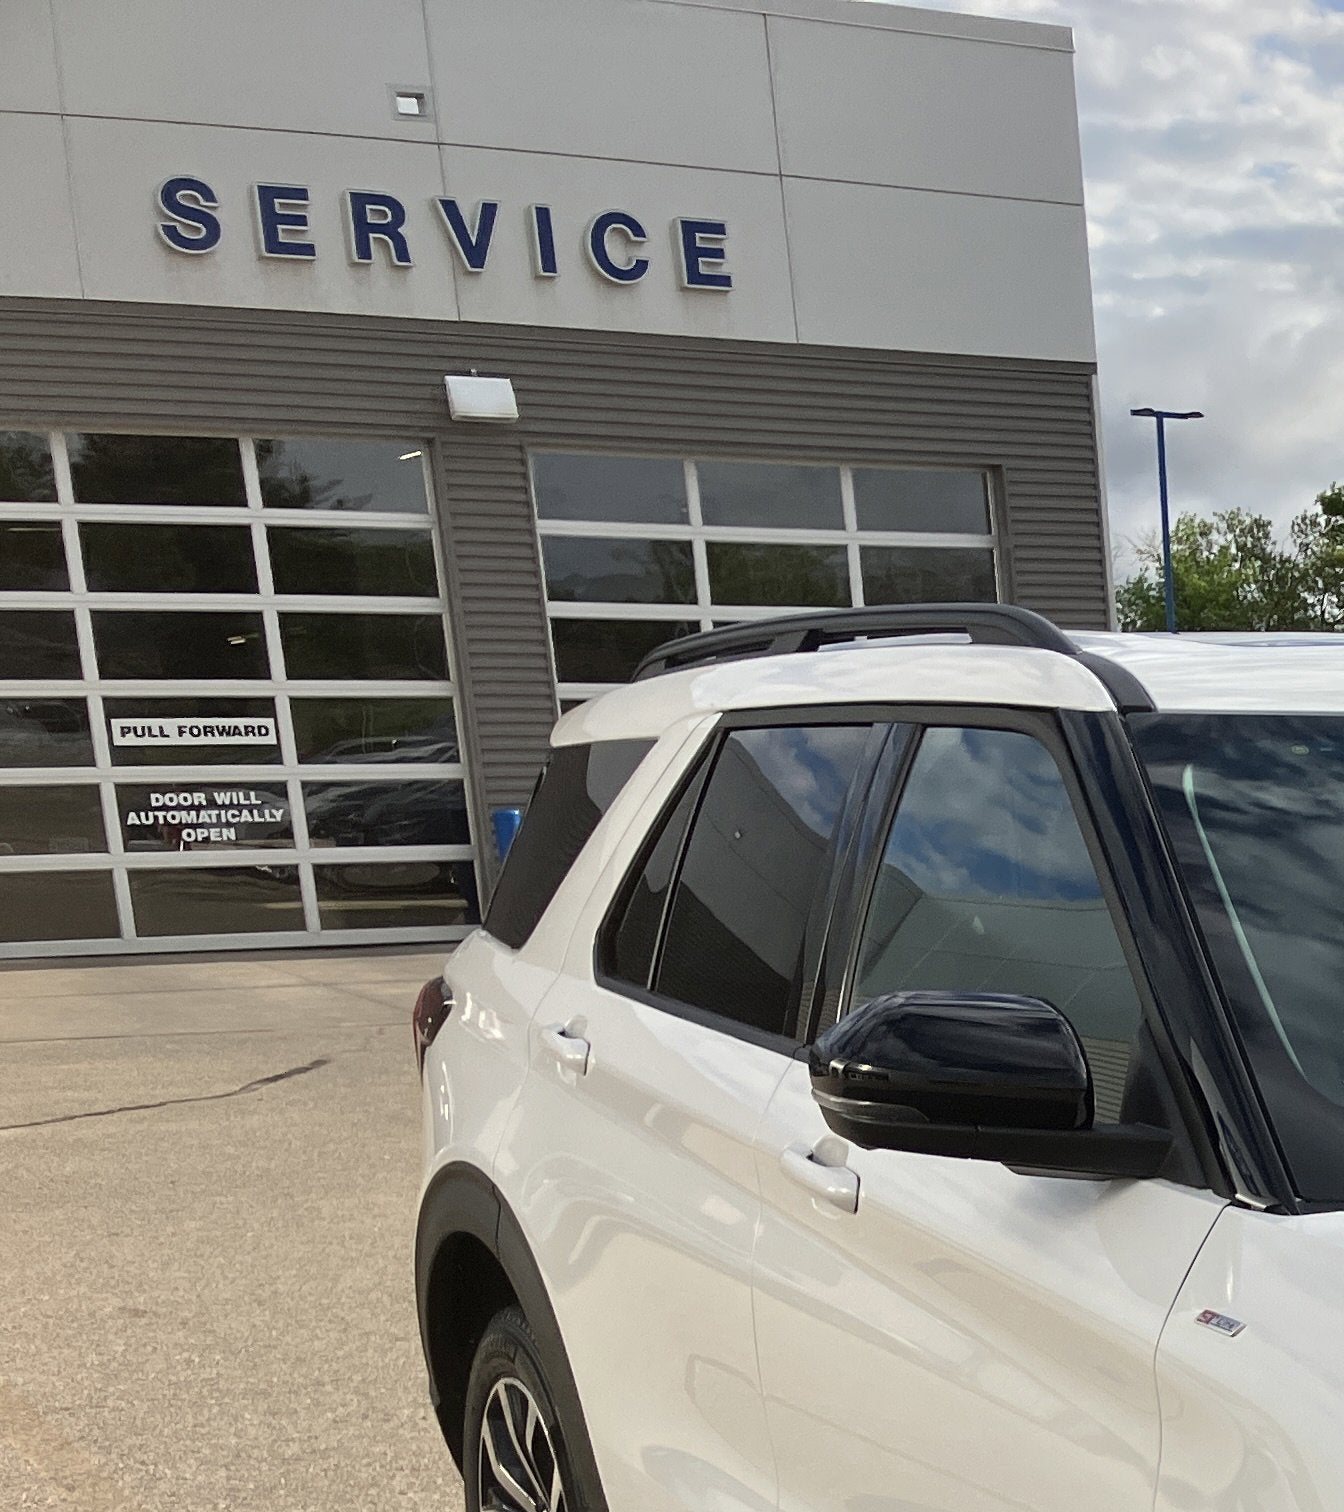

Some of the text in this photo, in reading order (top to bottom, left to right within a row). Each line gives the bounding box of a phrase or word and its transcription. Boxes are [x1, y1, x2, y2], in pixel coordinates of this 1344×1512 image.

[157, 174, 733, 291] SERVICE
[119, 724, 270, 738] PULL FORWARD
[150, 791, 262, 807] DOOR WILL
[126, 808, 285, 826] AUTOMATICALLY
[181, 826, 236, 842] OPEN
